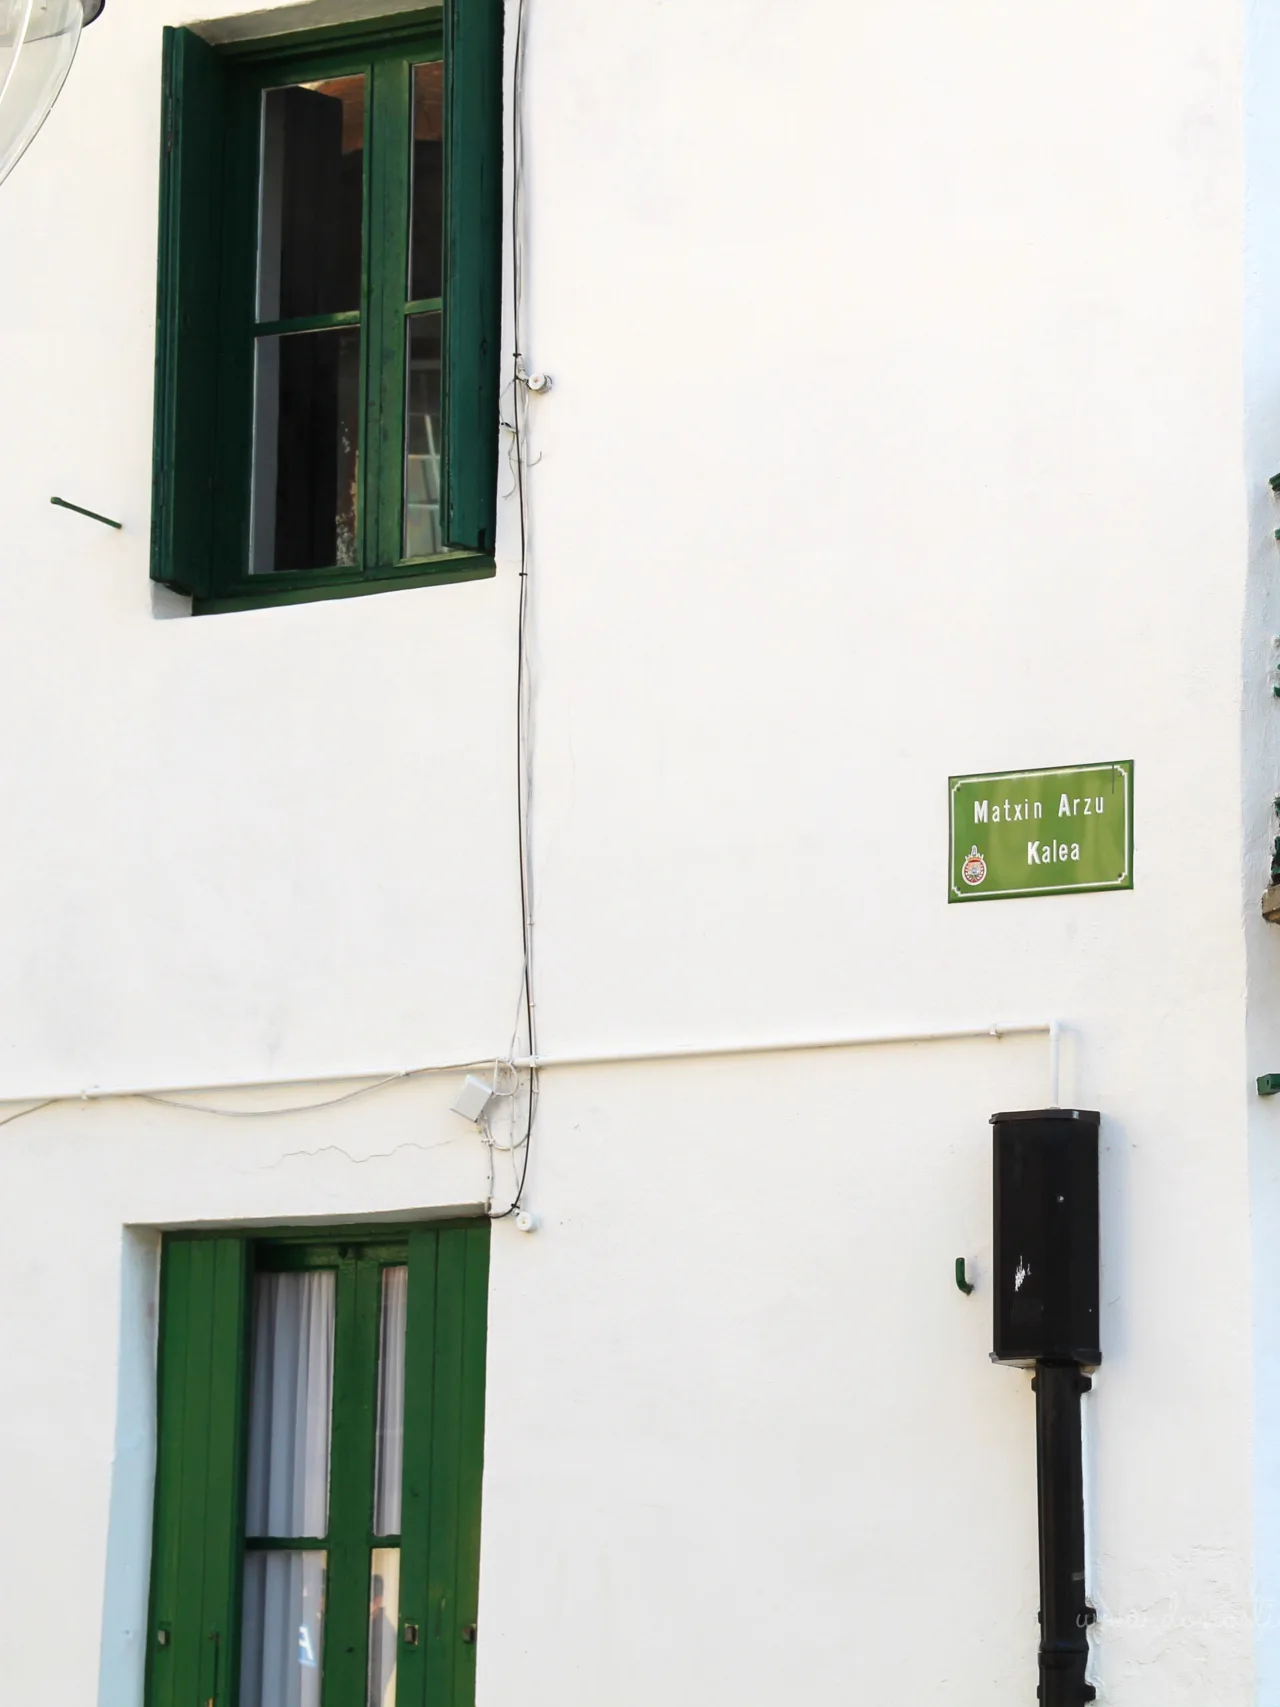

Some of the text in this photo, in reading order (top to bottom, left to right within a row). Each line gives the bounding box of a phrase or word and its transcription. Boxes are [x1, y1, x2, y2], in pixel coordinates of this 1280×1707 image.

[973, 793, 1104, 824] Matxin Arzu
[1027, 839, 1080, 865] Kalea
